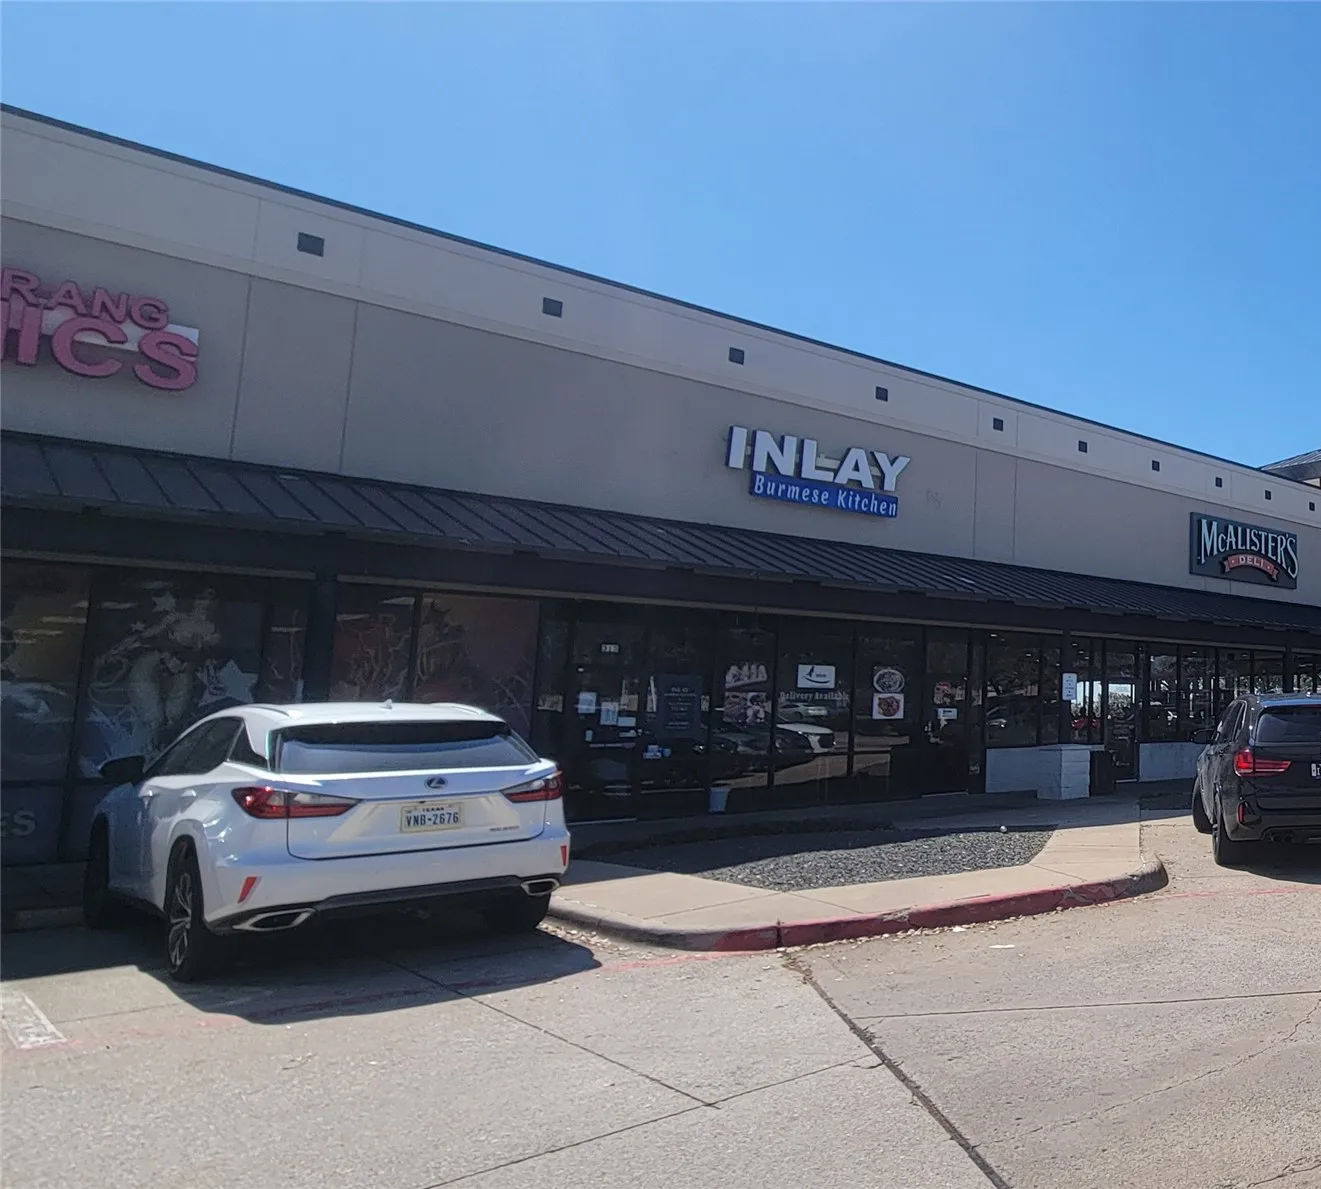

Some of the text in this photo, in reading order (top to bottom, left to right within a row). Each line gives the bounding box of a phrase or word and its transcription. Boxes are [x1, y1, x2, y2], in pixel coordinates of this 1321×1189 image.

[726, 425, 911, 492] INLAY
[754, 474, 897, 517] Burmese Kitchen
[1239, 555, 1264, 568] DELI
[406, 812, 459, 827] VNB-2676
